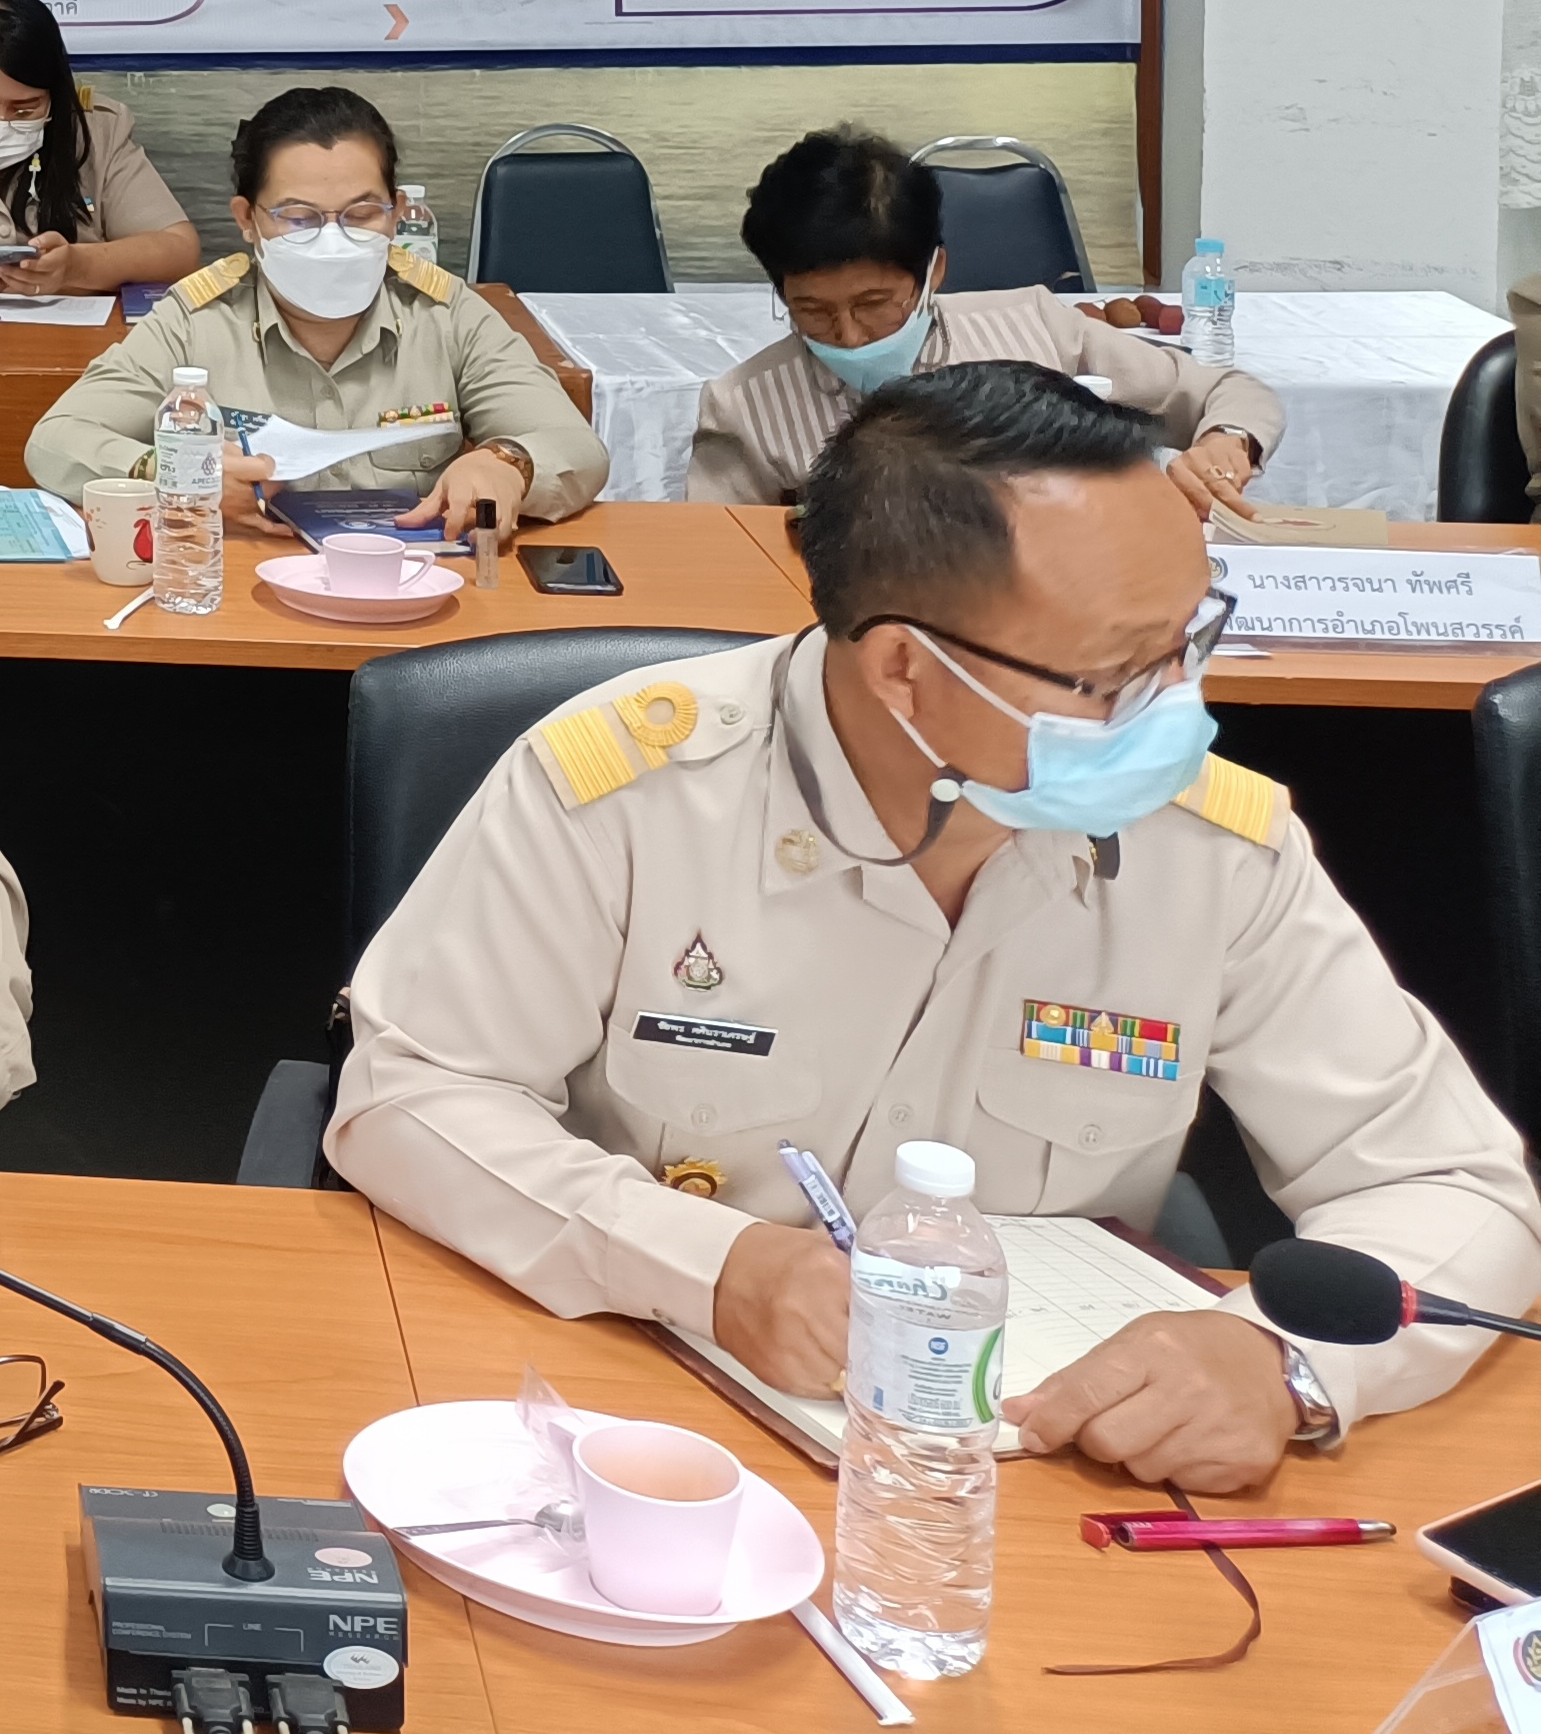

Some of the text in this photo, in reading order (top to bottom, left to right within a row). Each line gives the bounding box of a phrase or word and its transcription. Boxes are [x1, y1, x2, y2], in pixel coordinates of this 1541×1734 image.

[1248, 571, 1473, 597] นางสาวรจนา ทัพศรี
[1221, 613, 1524, 641] ฒนาการอำเภอโพนสวรรค์
[329, 1614, 398, 1634] NPE
